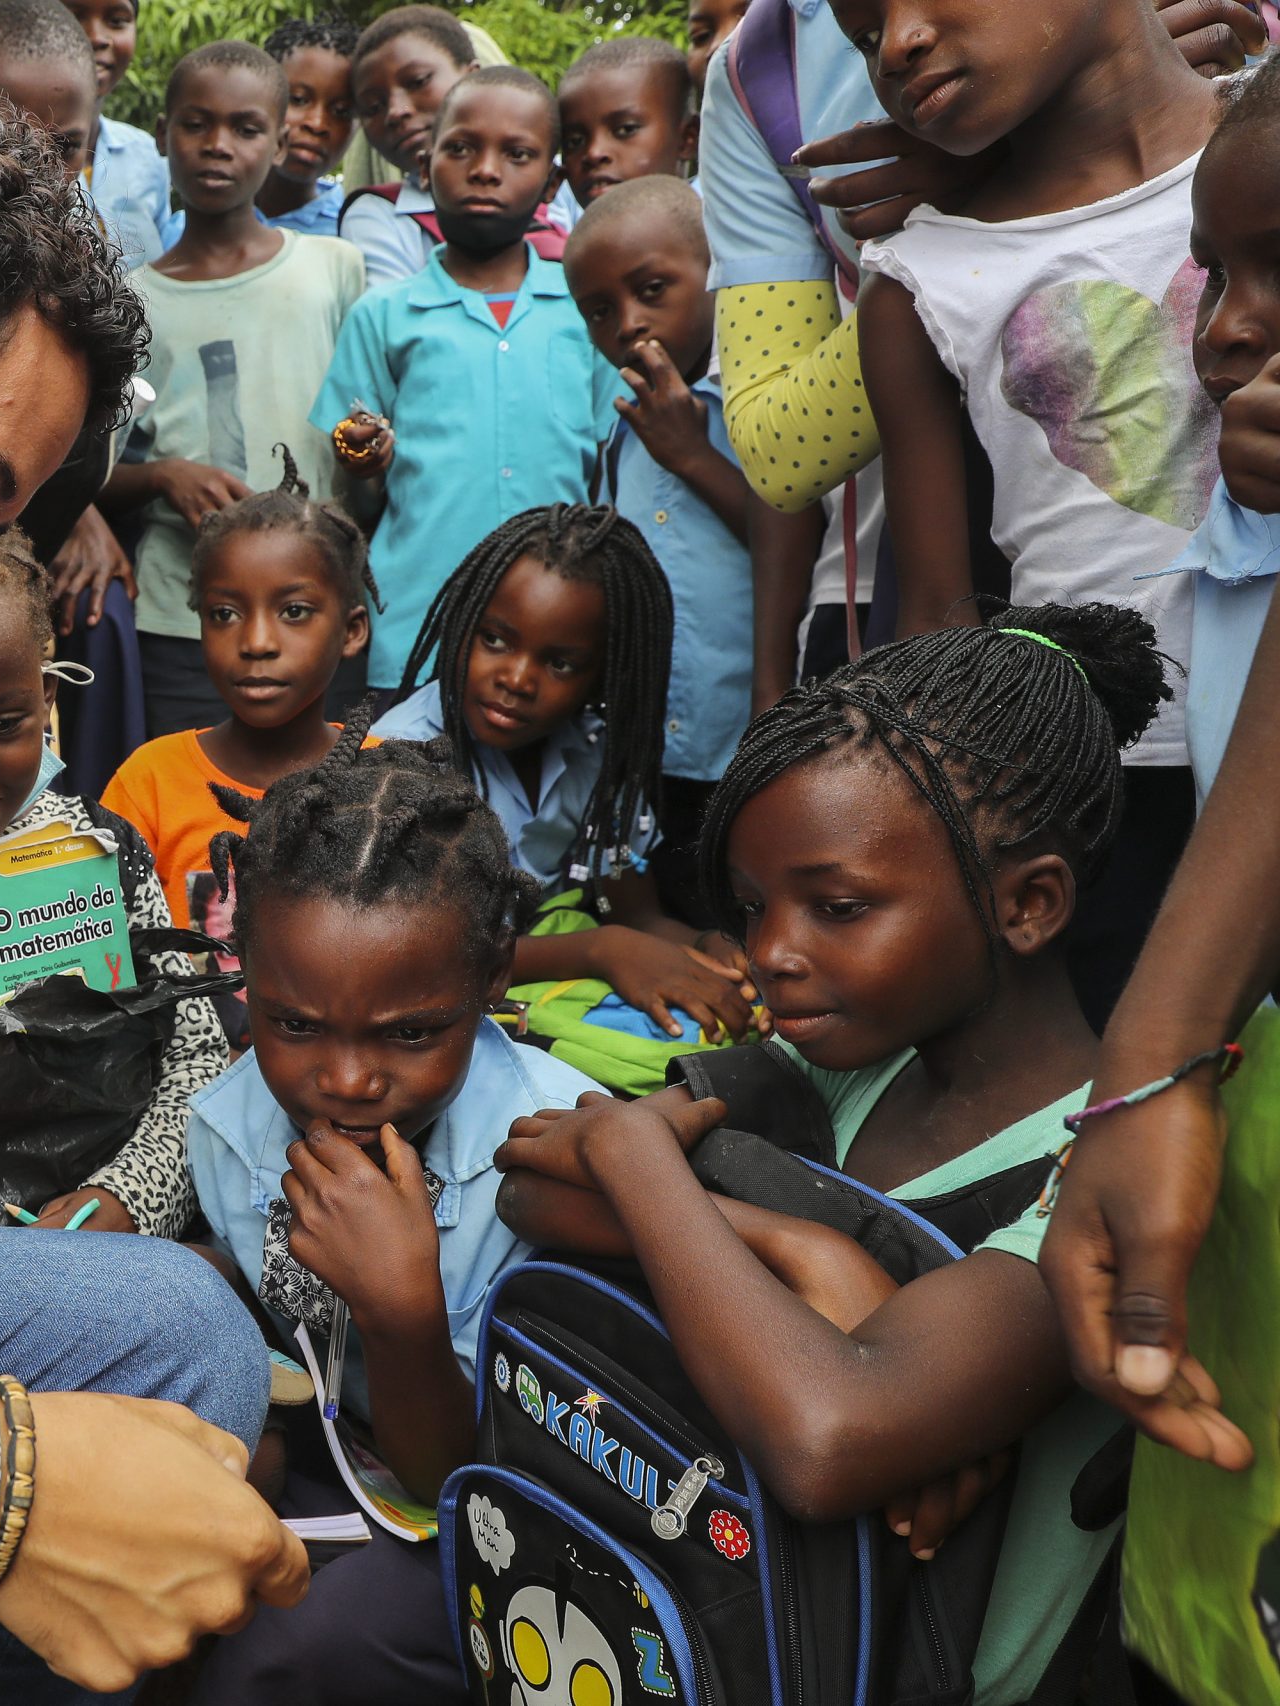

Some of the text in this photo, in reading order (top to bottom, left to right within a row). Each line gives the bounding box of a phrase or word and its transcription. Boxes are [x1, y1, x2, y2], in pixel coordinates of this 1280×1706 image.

[10, 848, 53, 864] Matemática
[64, 842, 85, 852] classe
[17, 888, 88, 928] mundo
[90, 882, 116, 909] da
[473, 1507, 501, 1537] Ultra
[477, 1525, 499, 1552] Man
